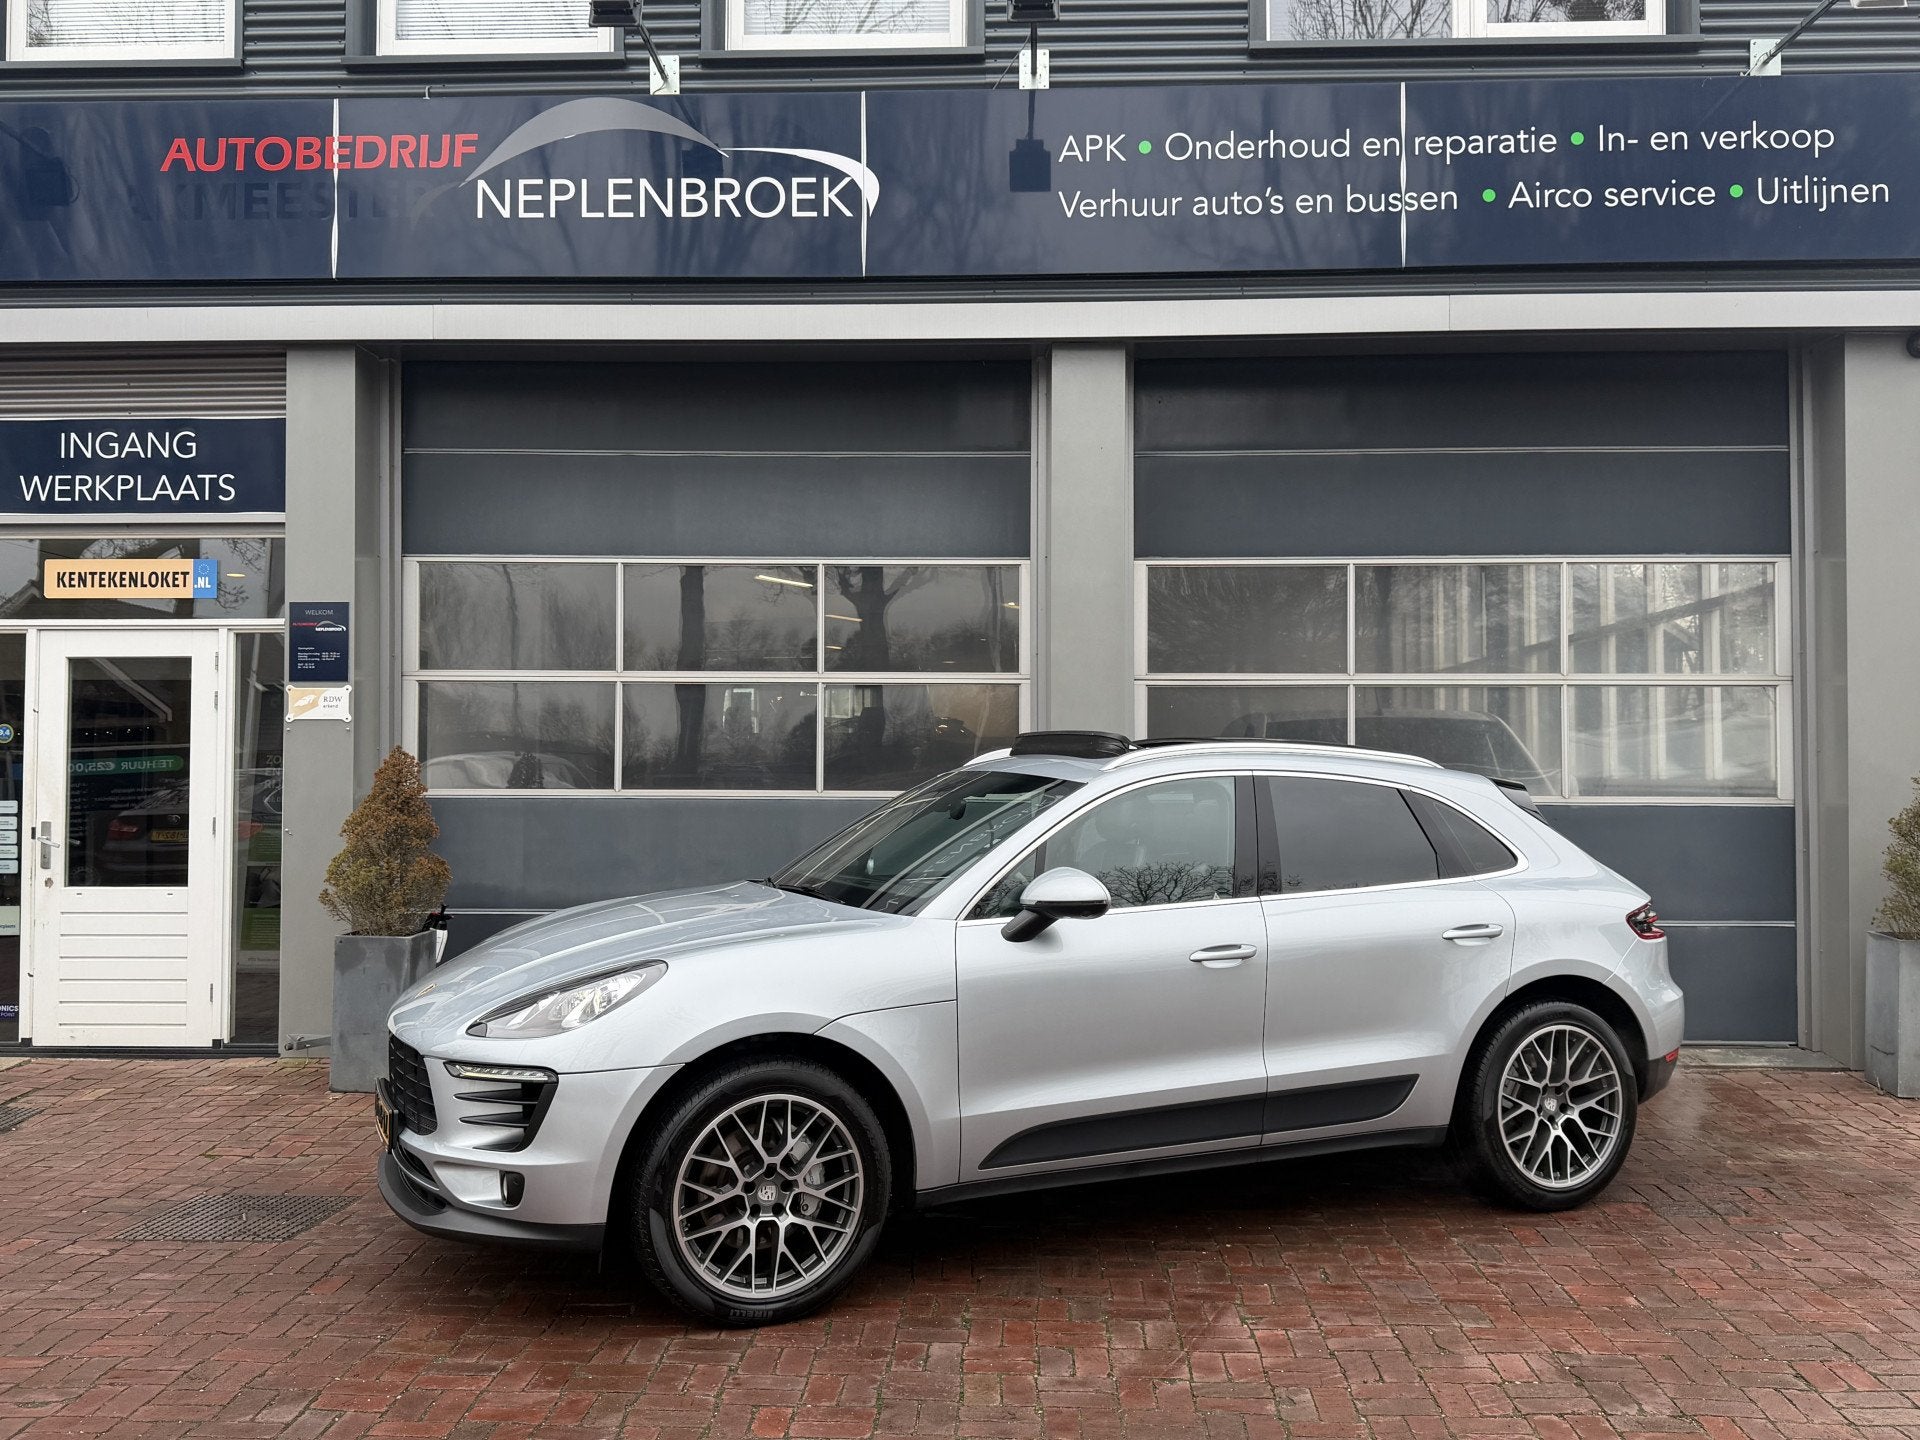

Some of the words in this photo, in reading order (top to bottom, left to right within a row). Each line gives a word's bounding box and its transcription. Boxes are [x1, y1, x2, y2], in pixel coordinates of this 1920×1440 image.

[160, 133, 478, 172] AUTOBEDRIJF
[1058, 133, 1128, 163] APK
[1164, 128, 1350, 161] Onderhoud
[1362, 137, 1400, 157] en
[1414, 126, 1558, 166] reparatie
[1599, 124, 1639, 152] In-
[1650, 131, 1688, 151] en
[1700, 120, 1836, 159] verkoop
[476, 174, 854, 220] NEPLENBROEK
[1057, 188, 1183, 219] Verhuur
[1295, 193, 1333, 214] en
[1346, 183, 1459, 213] bussen
[1508, 181, 1593, 209] Airco
[1604, 179, 1717, 208] service
[1757, 174, 1890, 212] Uitlijnen
[59, 430, 198, 460] INGANG
[19, 473, 237, 503] WERKPLAATS
